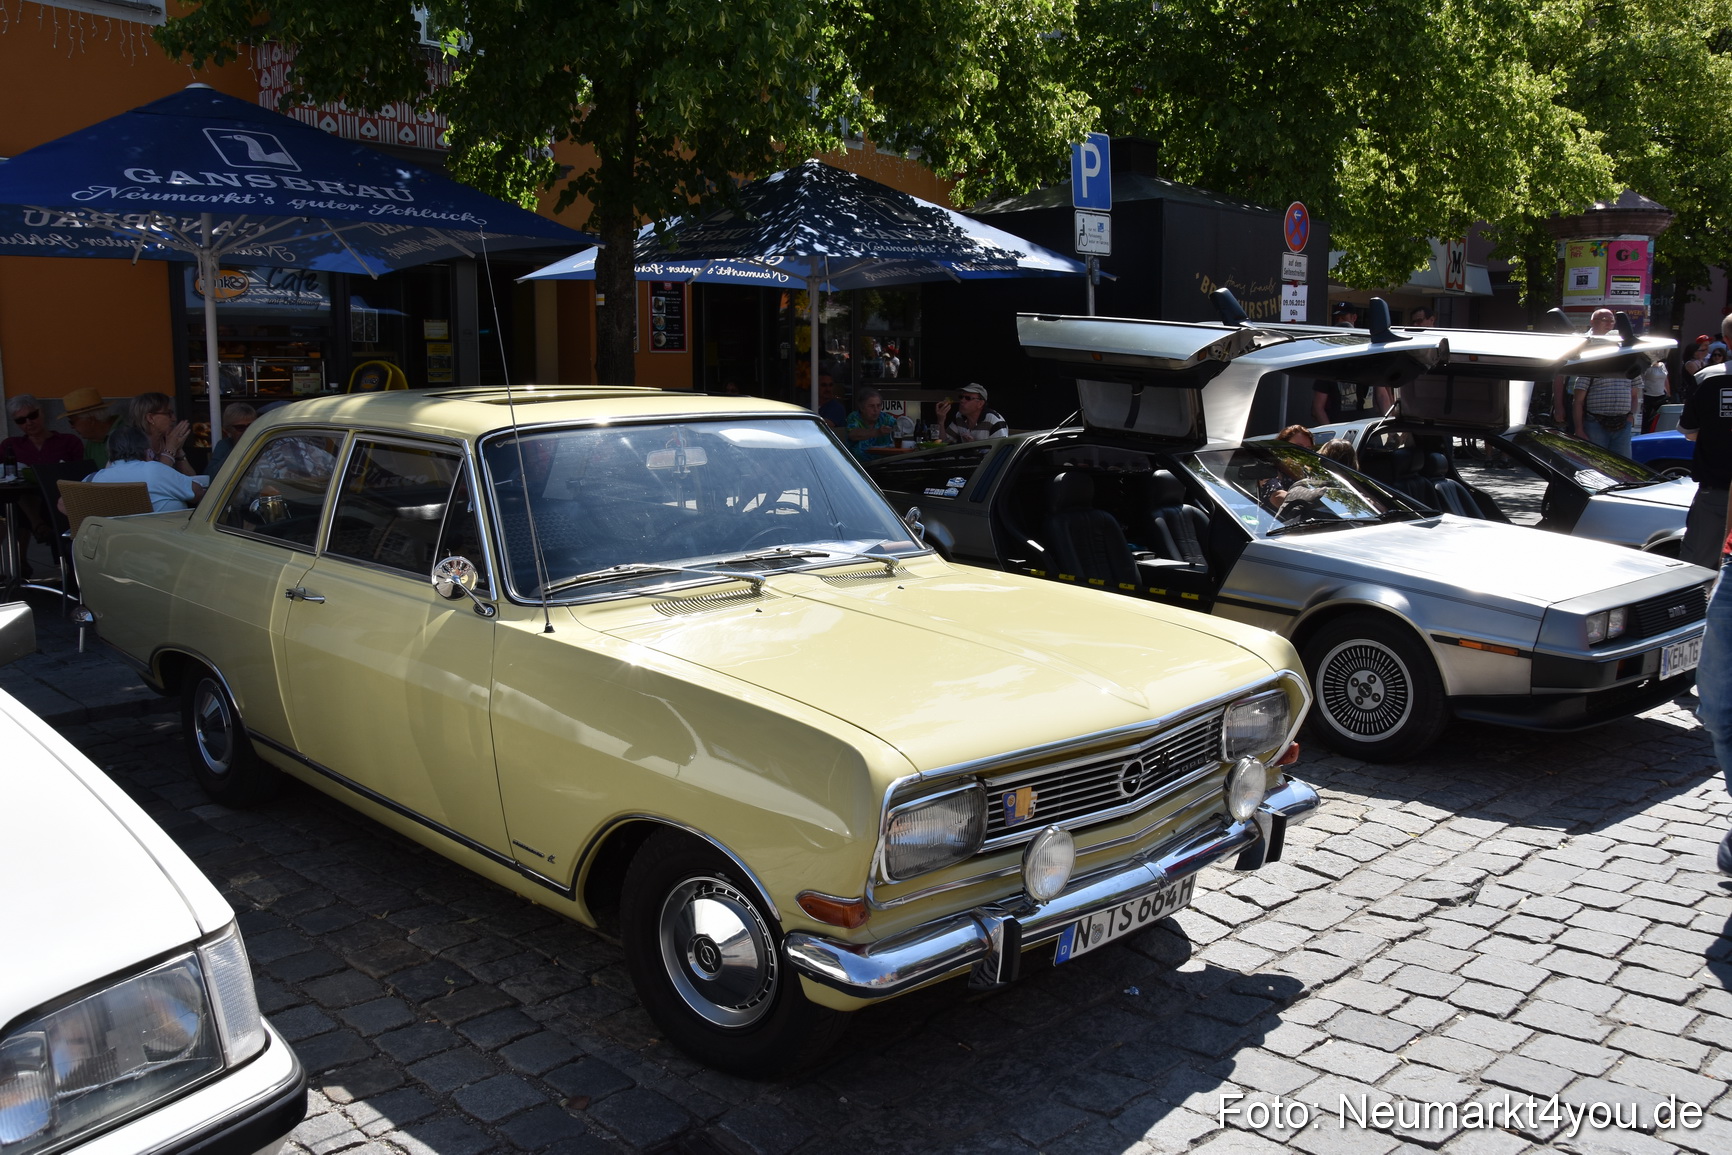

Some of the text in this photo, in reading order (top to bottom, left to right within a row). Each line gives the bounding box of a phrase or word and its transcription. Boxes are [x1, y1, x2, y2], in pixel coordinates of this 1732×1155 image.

[124, 168, 415, 202] GANSBRÄU
[1080, 142, 1101, 198] P
[71, 186, 488, 226] Neumarkt's guter Schluck
[1667, 646, 1685, 671] KEH
[1060, 944, 1068, 955] D
[1073, 915, 1093, 954] N
